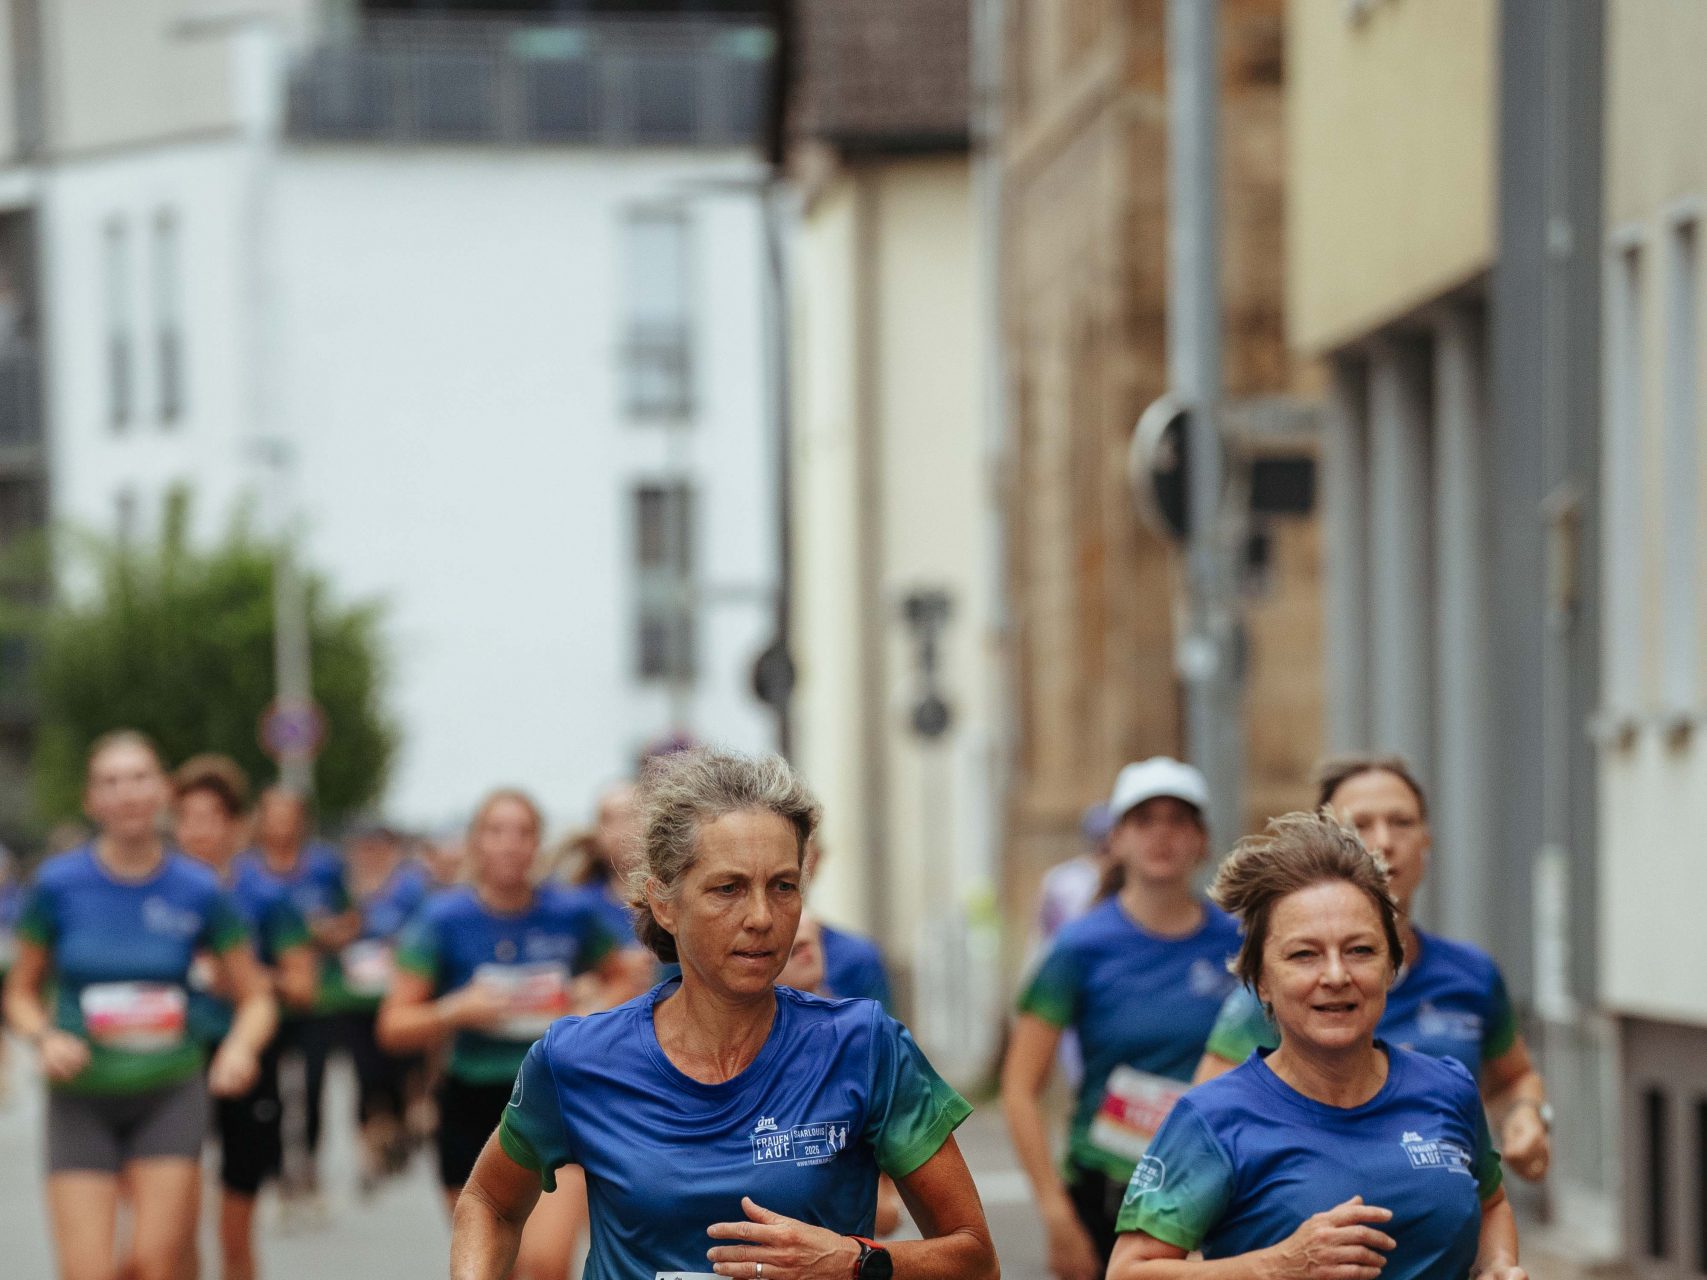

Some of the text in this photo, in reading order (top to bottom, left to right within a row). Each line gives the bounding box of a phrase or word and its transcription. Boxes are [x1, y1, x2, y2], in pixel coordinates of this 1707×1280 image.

[757, 1116, 775, 1128] dm
[794, 1128, 824, 1138] SAARLOUIS
[757, 1134, 789, 1149] FRAUEN
[757, 1142, 790, 1160] LAUF
[1412, 1150, 1441, 1166] LAUF
